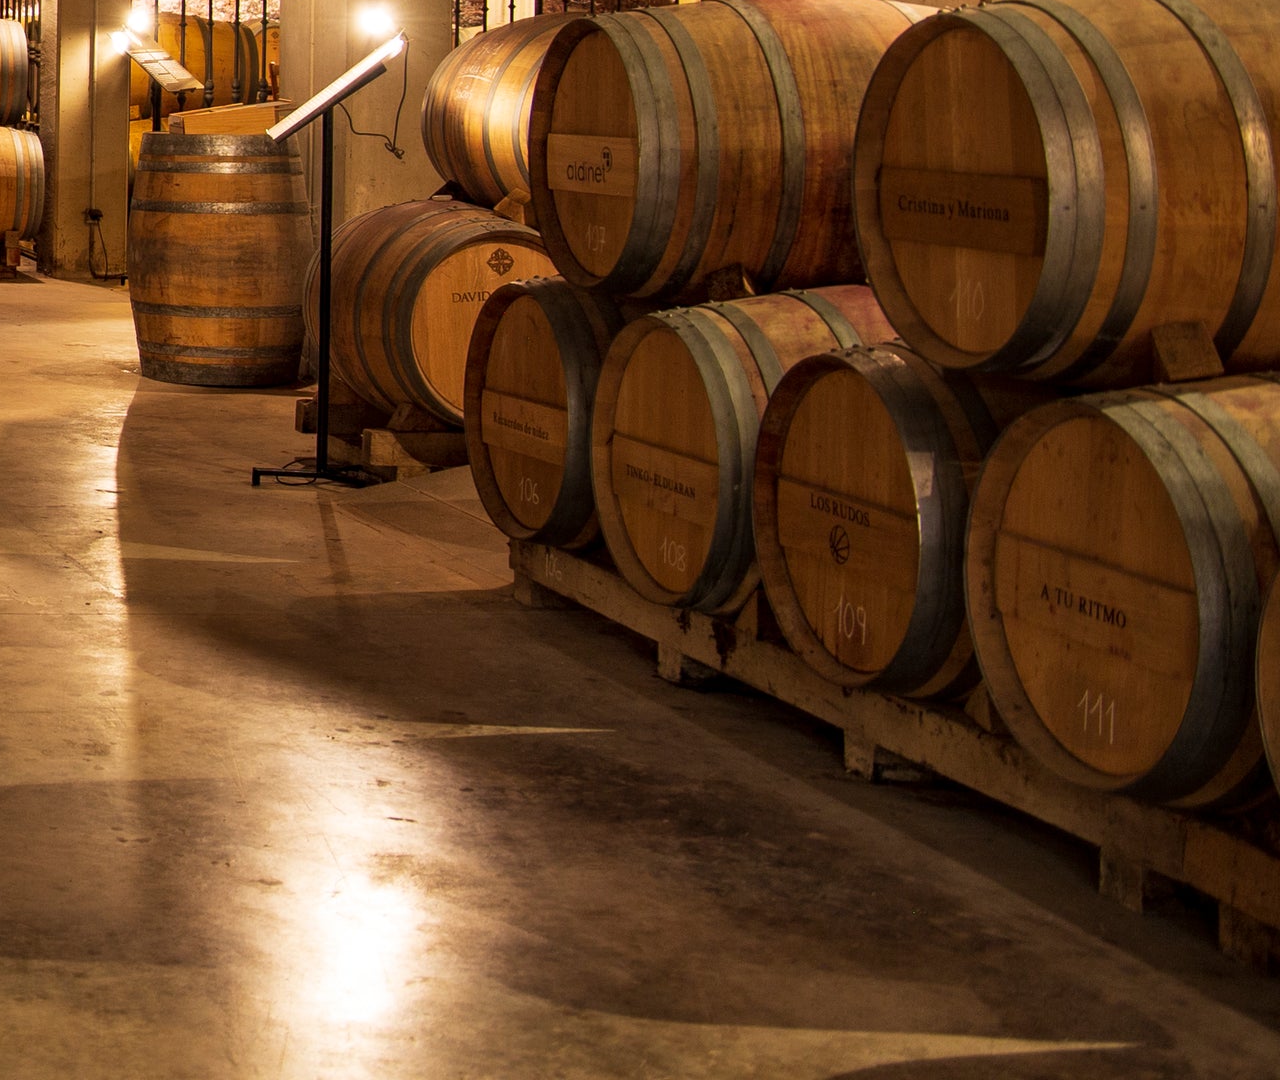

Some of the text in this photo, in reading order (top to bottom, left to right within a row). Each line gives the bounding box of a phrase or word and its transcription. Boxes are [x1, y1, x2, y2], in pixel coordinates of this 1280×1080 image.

[566, 160, 606, 183] aldinet
[898, 195, 1010, 221] Cristina y Mariona
[451, 291, 491, 304] DAVID
[949, 279, 985, 320] 110
[523, 423, 531, 434] de
[518, 477, 539, 505] 106
[810, 493, 870, 528] LOS RUDOS
[659, 536, 687, 572] 108
[833, 593, 867, 646] 109
[1040, 583, 1127, 629] A TU RITMO
[1077, 688, 1115, 745] 111
